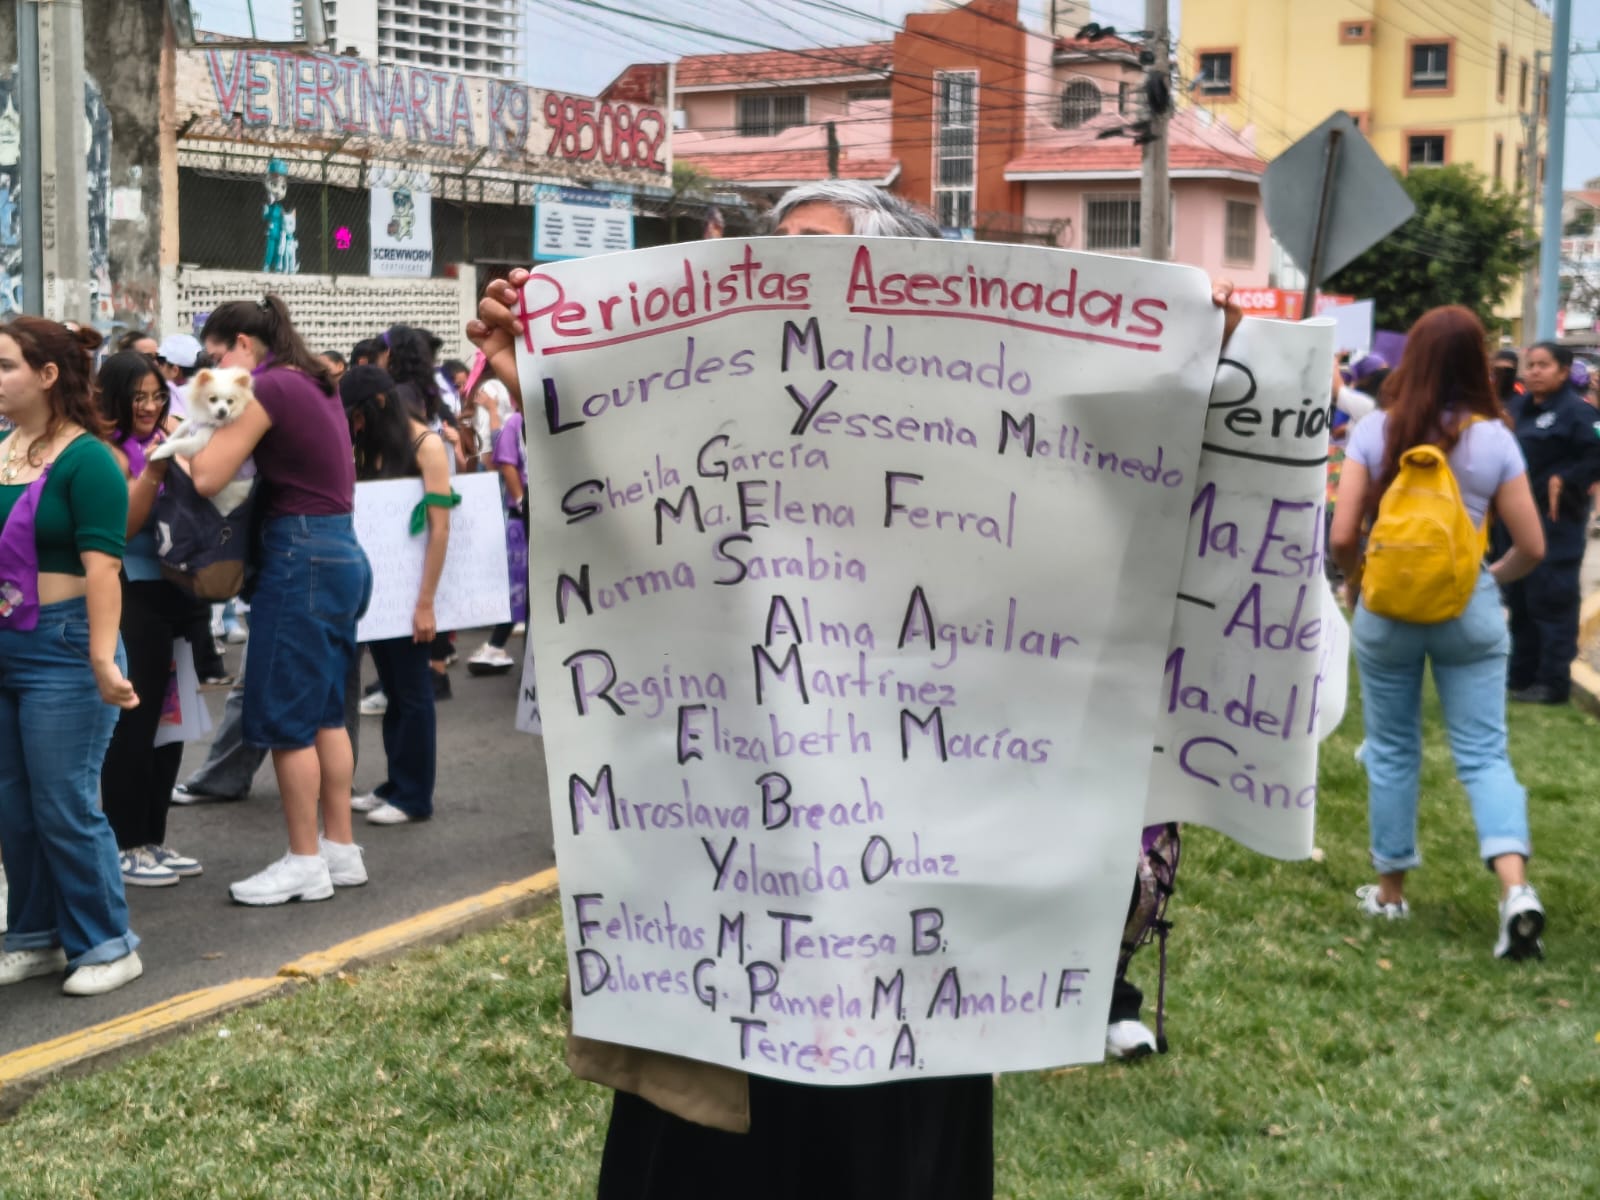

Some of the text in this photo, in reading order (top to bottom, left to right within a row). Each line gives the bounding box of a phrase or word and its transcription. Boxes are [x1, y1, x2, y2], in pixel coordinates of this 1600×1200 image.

[206, 47, 666, 172] VETERINARIA K9 9850862
[373, 247, 432, 262] SCREWWORM
[517, 243, 1168, 354] Periodistas Asesinadas
[541, 316, 1032, 435] Lourdes Maldonado
[784, 379, 1184, 488] Yessenia Mollinedo
[560, 453, 682, 525] Sheila
[654, 471, 1016, 549] Ma. Elena Ferral
[1252, 498, 1324, 577] Est
[556, 564, 696, 625] Norma
[711, 533, 867, 586] Sarabia
[764, 585, 1079, 670] Alma Aguilar
[562, 642, 957, 719] Regina Martínez
[677, 704, 1055, 766] Elizabeth Macías
[568, 763, 884, 837] Miroslava Breach
[700, 831, 960, 893] Yolanda Ordaz
[572, 893, 706, 951] Felicitas
[716, 910, 753, 965] M.
[766, 910, 897, 963] Teresa
[575, 948, 690, 997] Dolores
[693, 958, 729, 1012] G.
[745, 960, 862, 1022] Pamela
[926, 966, 1048, 1020] Anabel
[730, 1016, 876, 1075] Teresa
